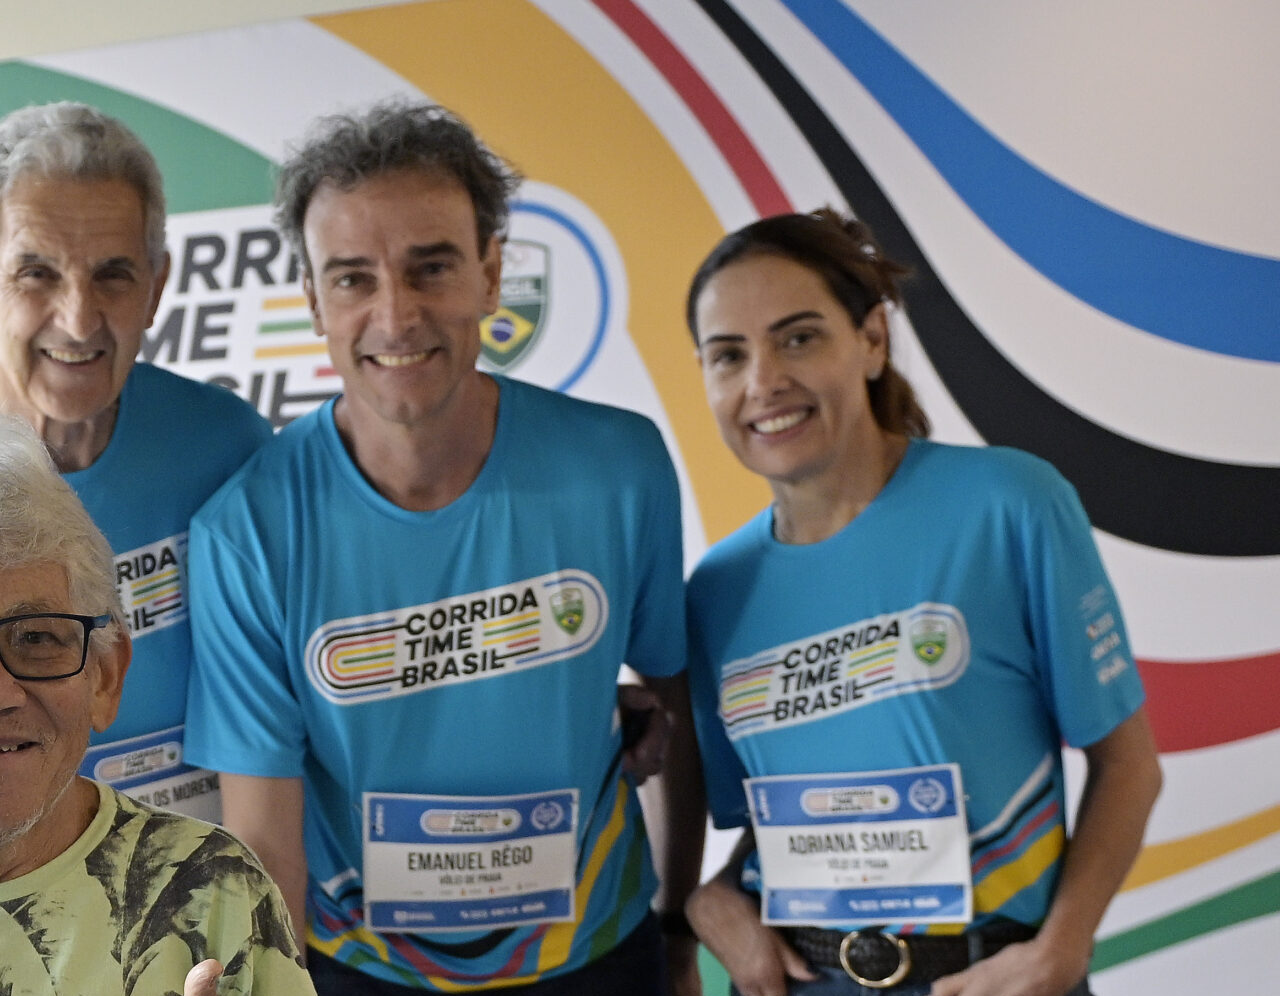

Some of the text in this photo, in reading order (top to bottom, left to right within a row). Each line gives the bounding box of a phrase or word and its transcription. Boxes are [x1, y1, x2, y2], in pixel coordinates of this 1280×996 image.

[125, 606, 156, 631] IL
[406, 587, 538, 636] CORRIDA
[404, 627, 473, 660] TIME
[784, 619, 900, 669] CORRIDA
[401, 648, 505, 688] BRASIL
[781, 659, 841, 694] TIME
[774, 680, 865, 721] BRASIL
[788, 829, 928, 854] ADRIANA SAMUEL
[408, 852, 486, 871] EMANUEL
